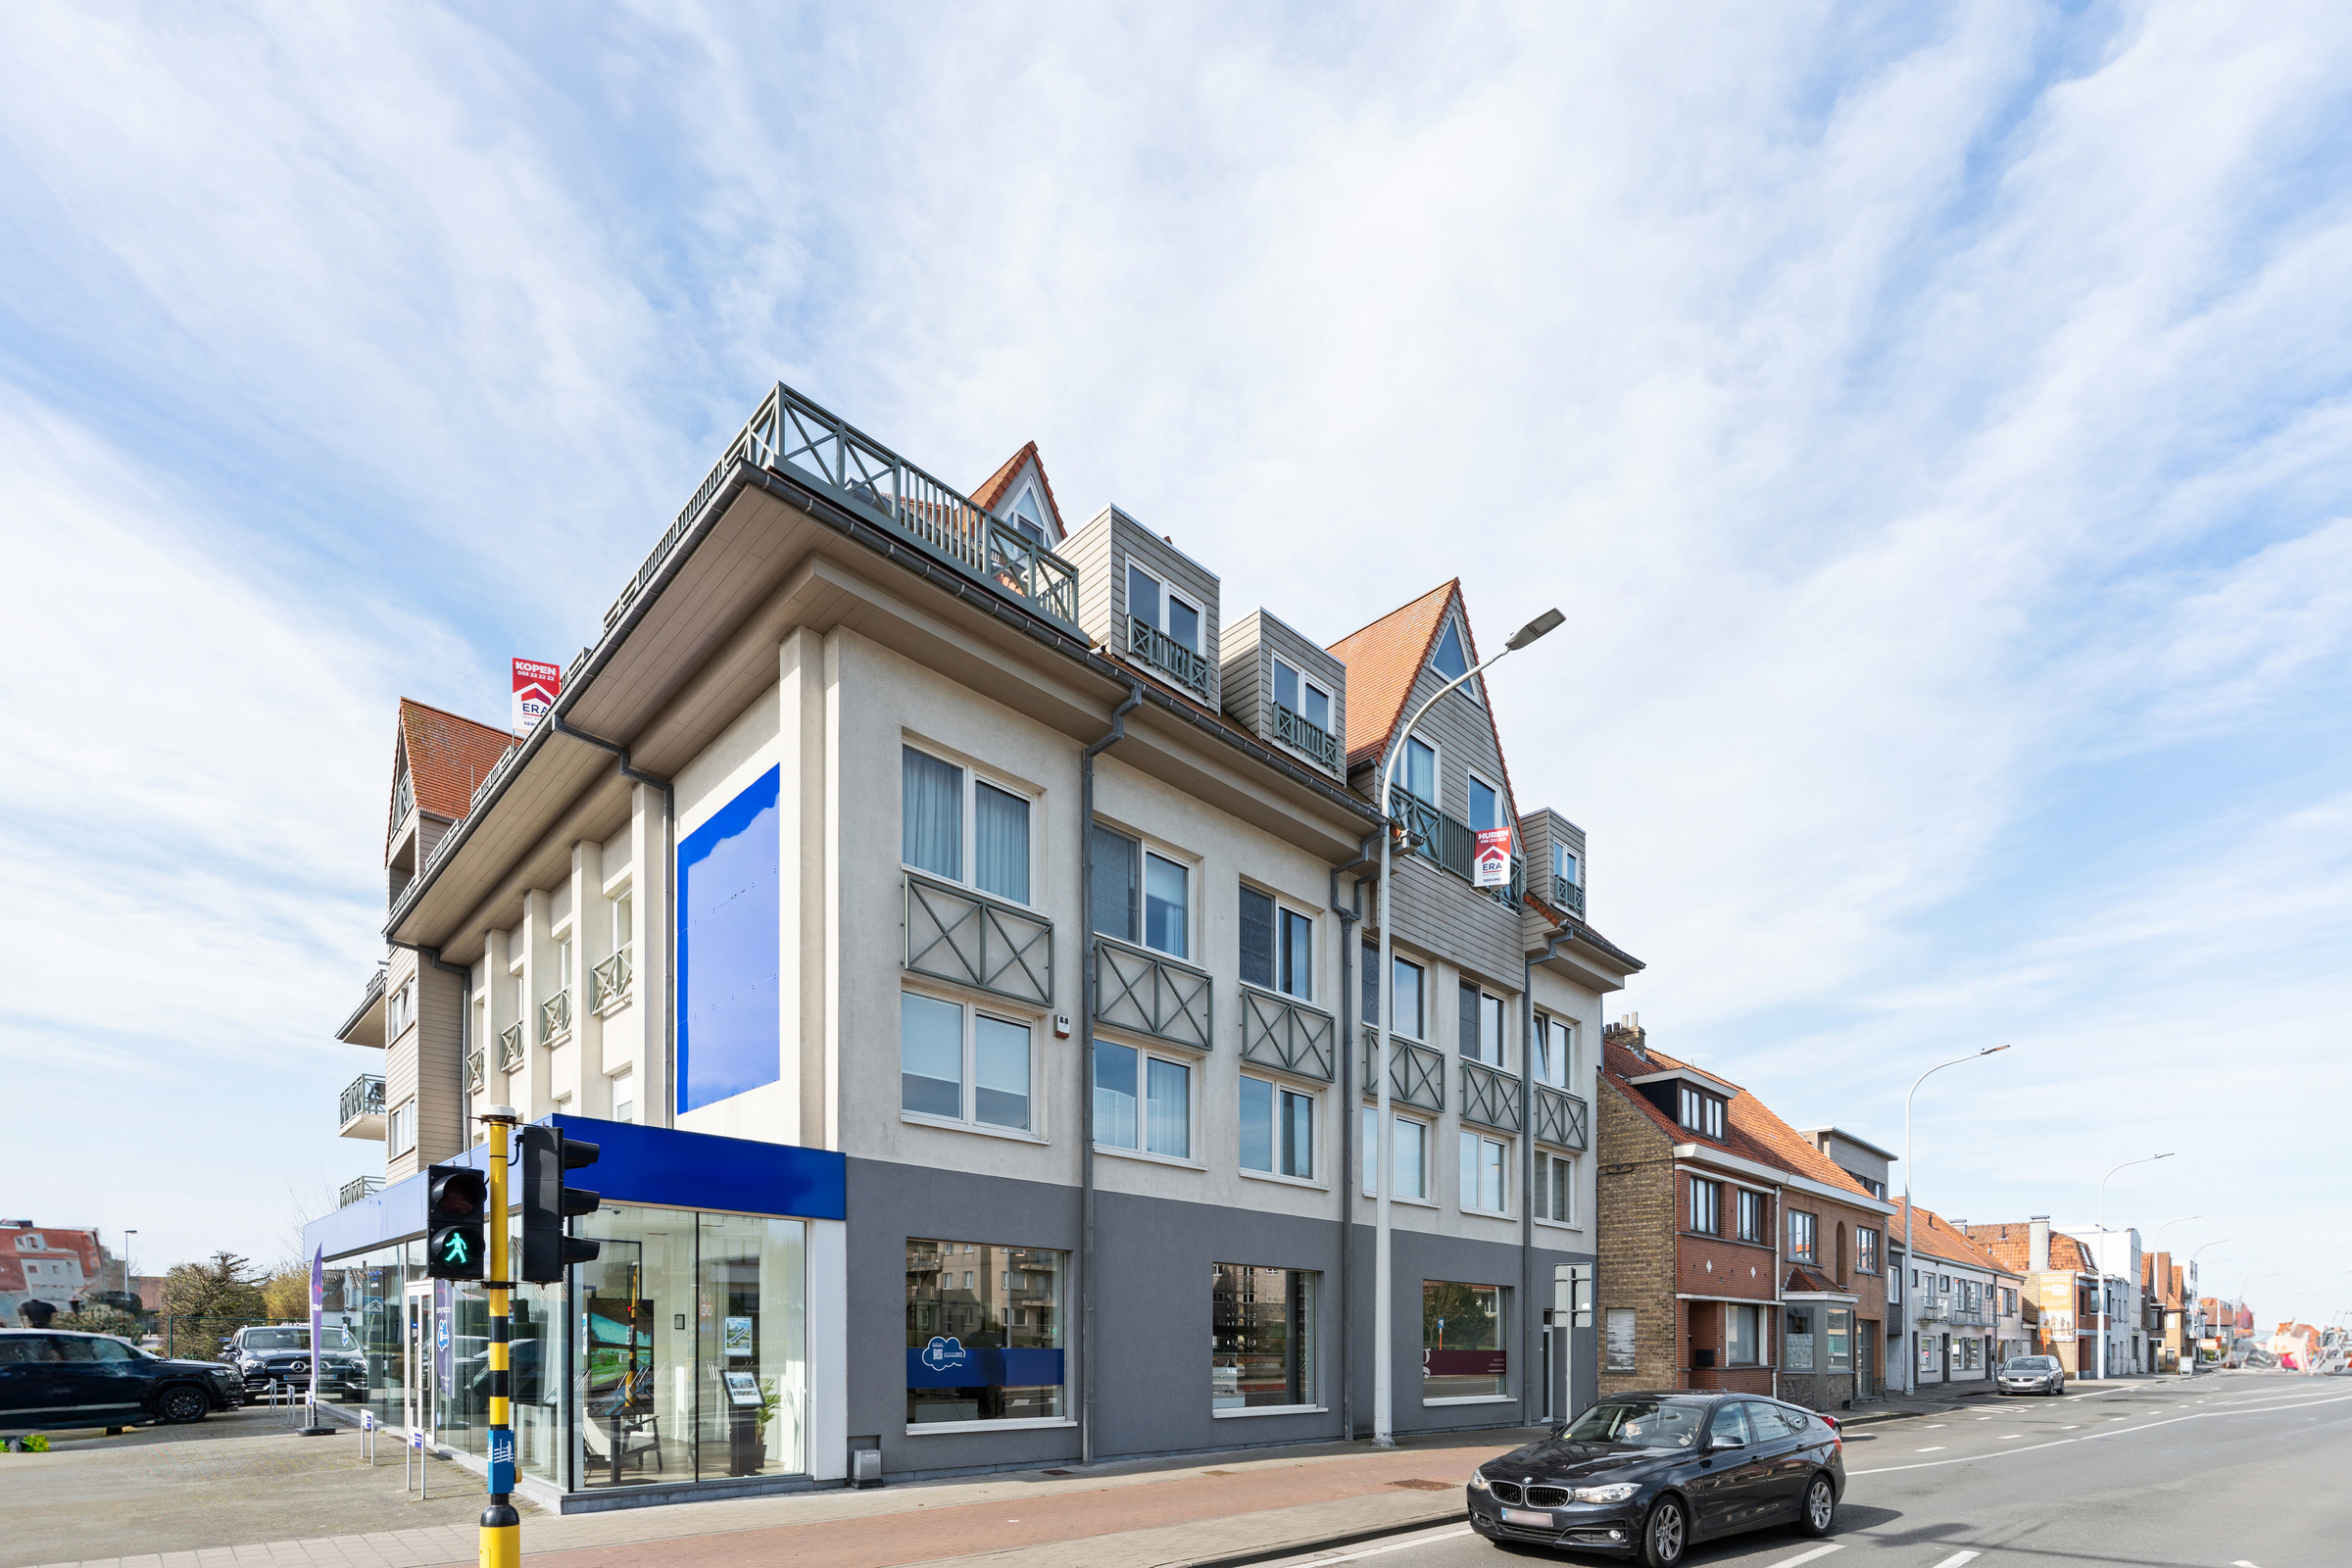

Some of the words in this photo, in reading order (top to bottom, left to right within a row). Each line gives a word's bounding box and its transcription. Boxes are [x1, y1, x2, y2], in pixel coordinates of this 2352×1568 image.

[515, 661, 557, 676] KOPEN
[1478, 829, 1509, 841] HUREN
[1483, 862, 1502, 871] ERA
